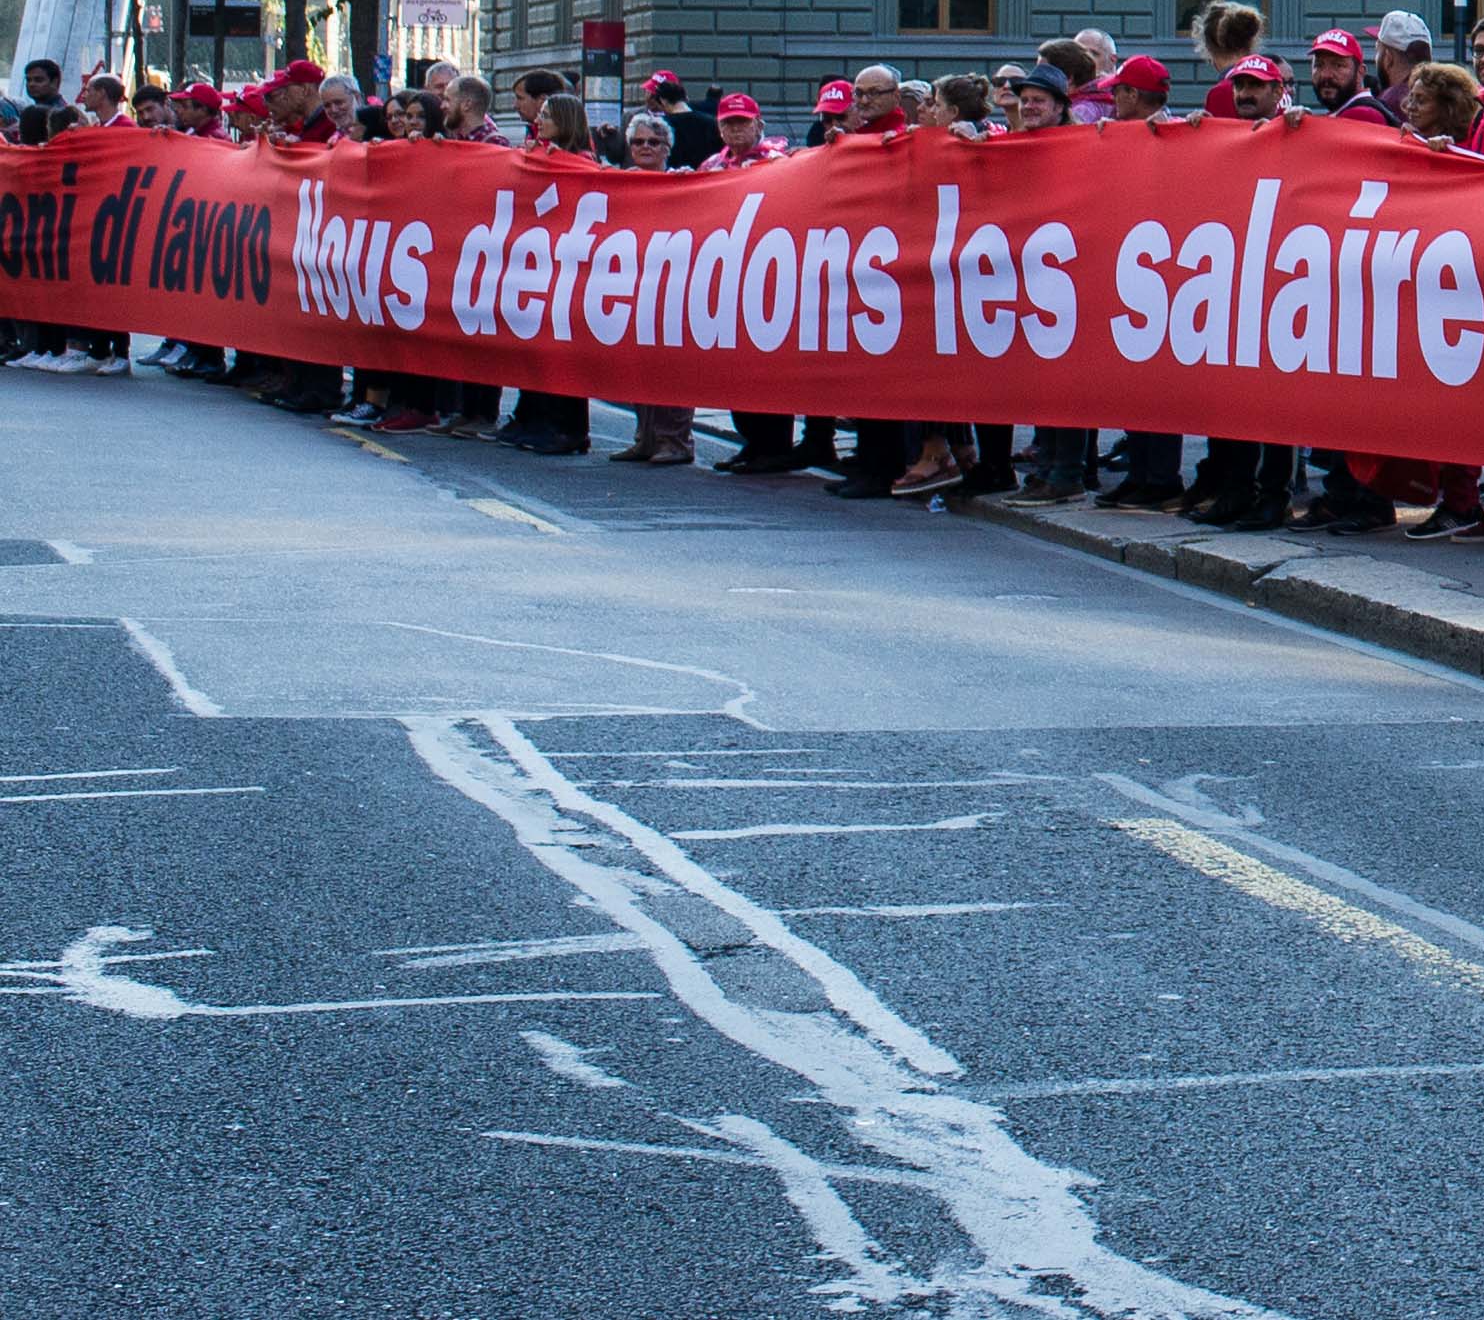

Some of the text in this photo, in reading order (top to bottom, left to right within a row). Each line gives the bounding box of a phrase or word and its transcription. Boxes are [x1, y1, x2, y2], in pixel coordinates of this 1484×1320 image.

[90, 166, 158, 287] di
[148, 169, 272, 306] lavoro
[292, 178, 433, 331] Nous
[451, 185, 902, 355] défendons
[929, 184, 1078, 360] les
